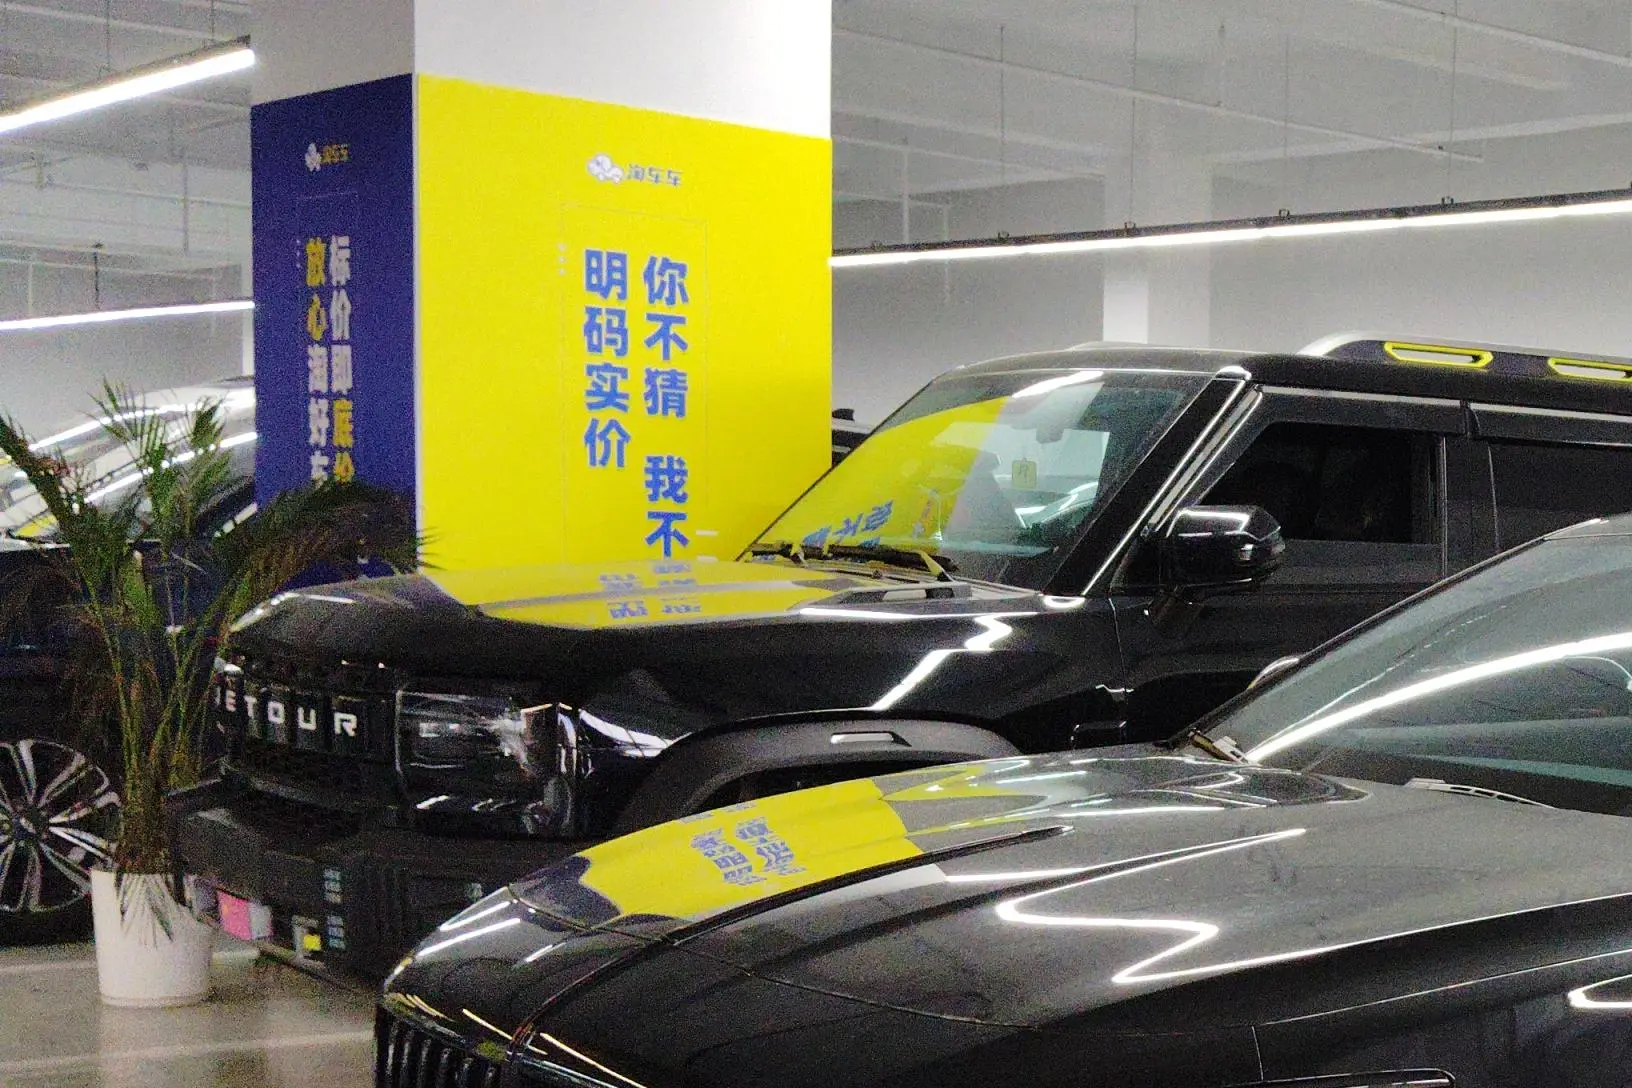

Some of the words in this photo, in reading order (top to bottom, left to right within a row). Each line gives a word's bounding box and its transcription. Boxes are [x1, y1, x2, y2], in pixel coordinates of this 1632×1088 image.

[627, 164, 683, 186] 淘车车
[583, 249, 630, 468] 明码实价
[643, 256, 690, 418] 你不猜
[643, 455, 690, 558] 我不
